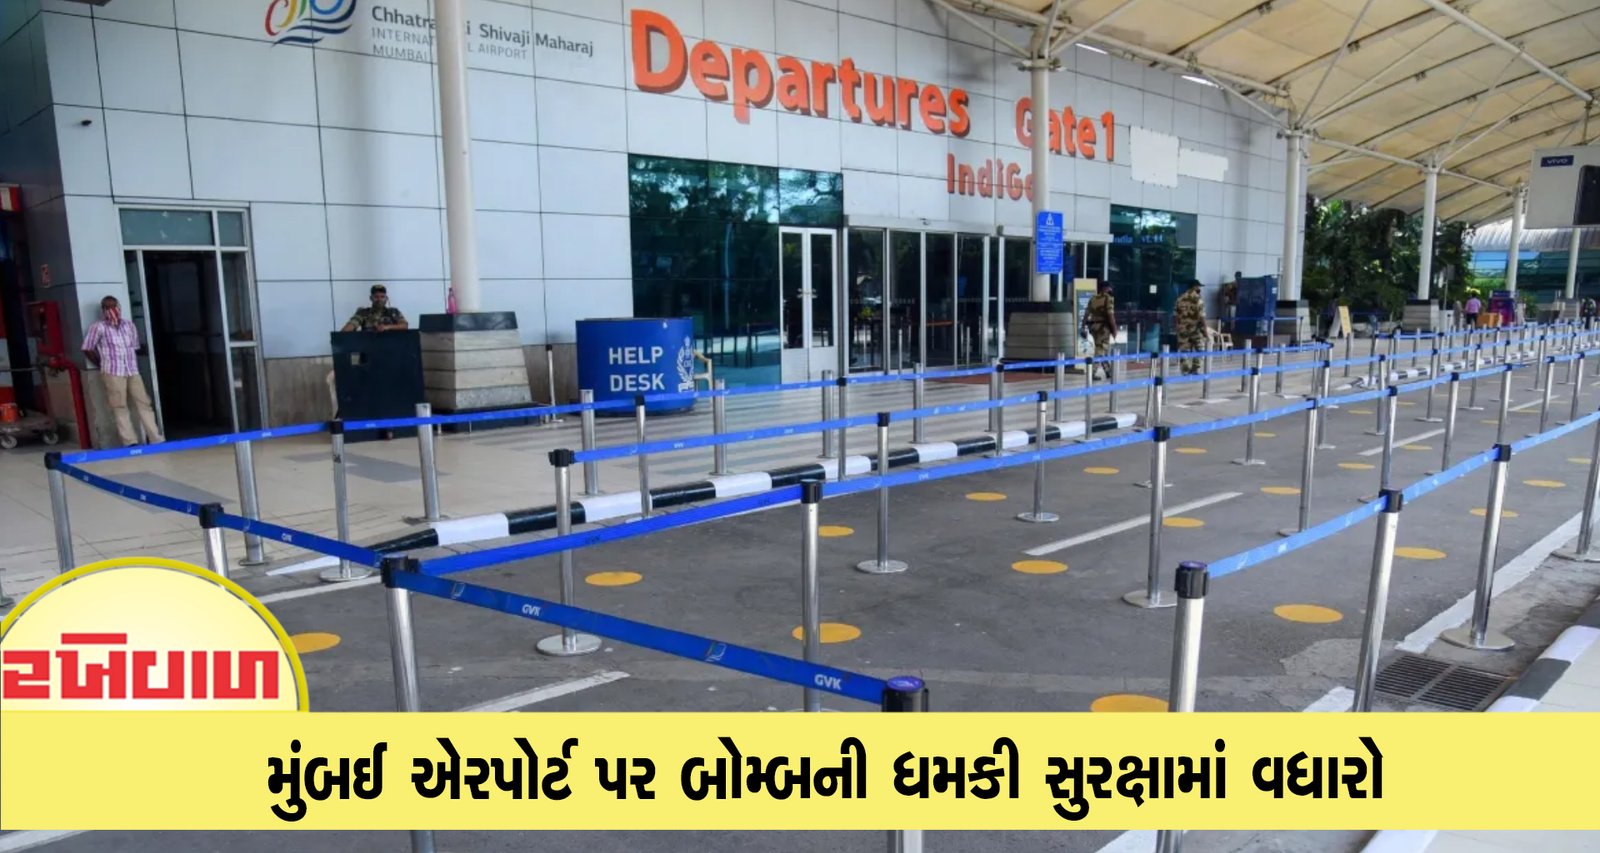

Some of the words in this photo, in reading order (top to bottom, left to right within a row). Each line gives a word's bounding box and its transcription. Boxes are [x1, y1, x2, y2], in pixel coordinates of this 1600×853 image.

[479, 23, 530, 48] Shivaji
[535, 32, 594, 58] Maharaj
[373, 43, 429, 62] MUMBAI
[478, 43, 528, 60] AIRPORT
[631, 9, 971, 137] Departures
[1016, 97, 1097, 160] Gate
[1101, 111, 1115, 162] 1
[608, 346, 664, 365] HELP
[610, 373, 666, 392] DESK
[522, 603, 542, 617] GVK
[814, 673, 843, 690] GVK
